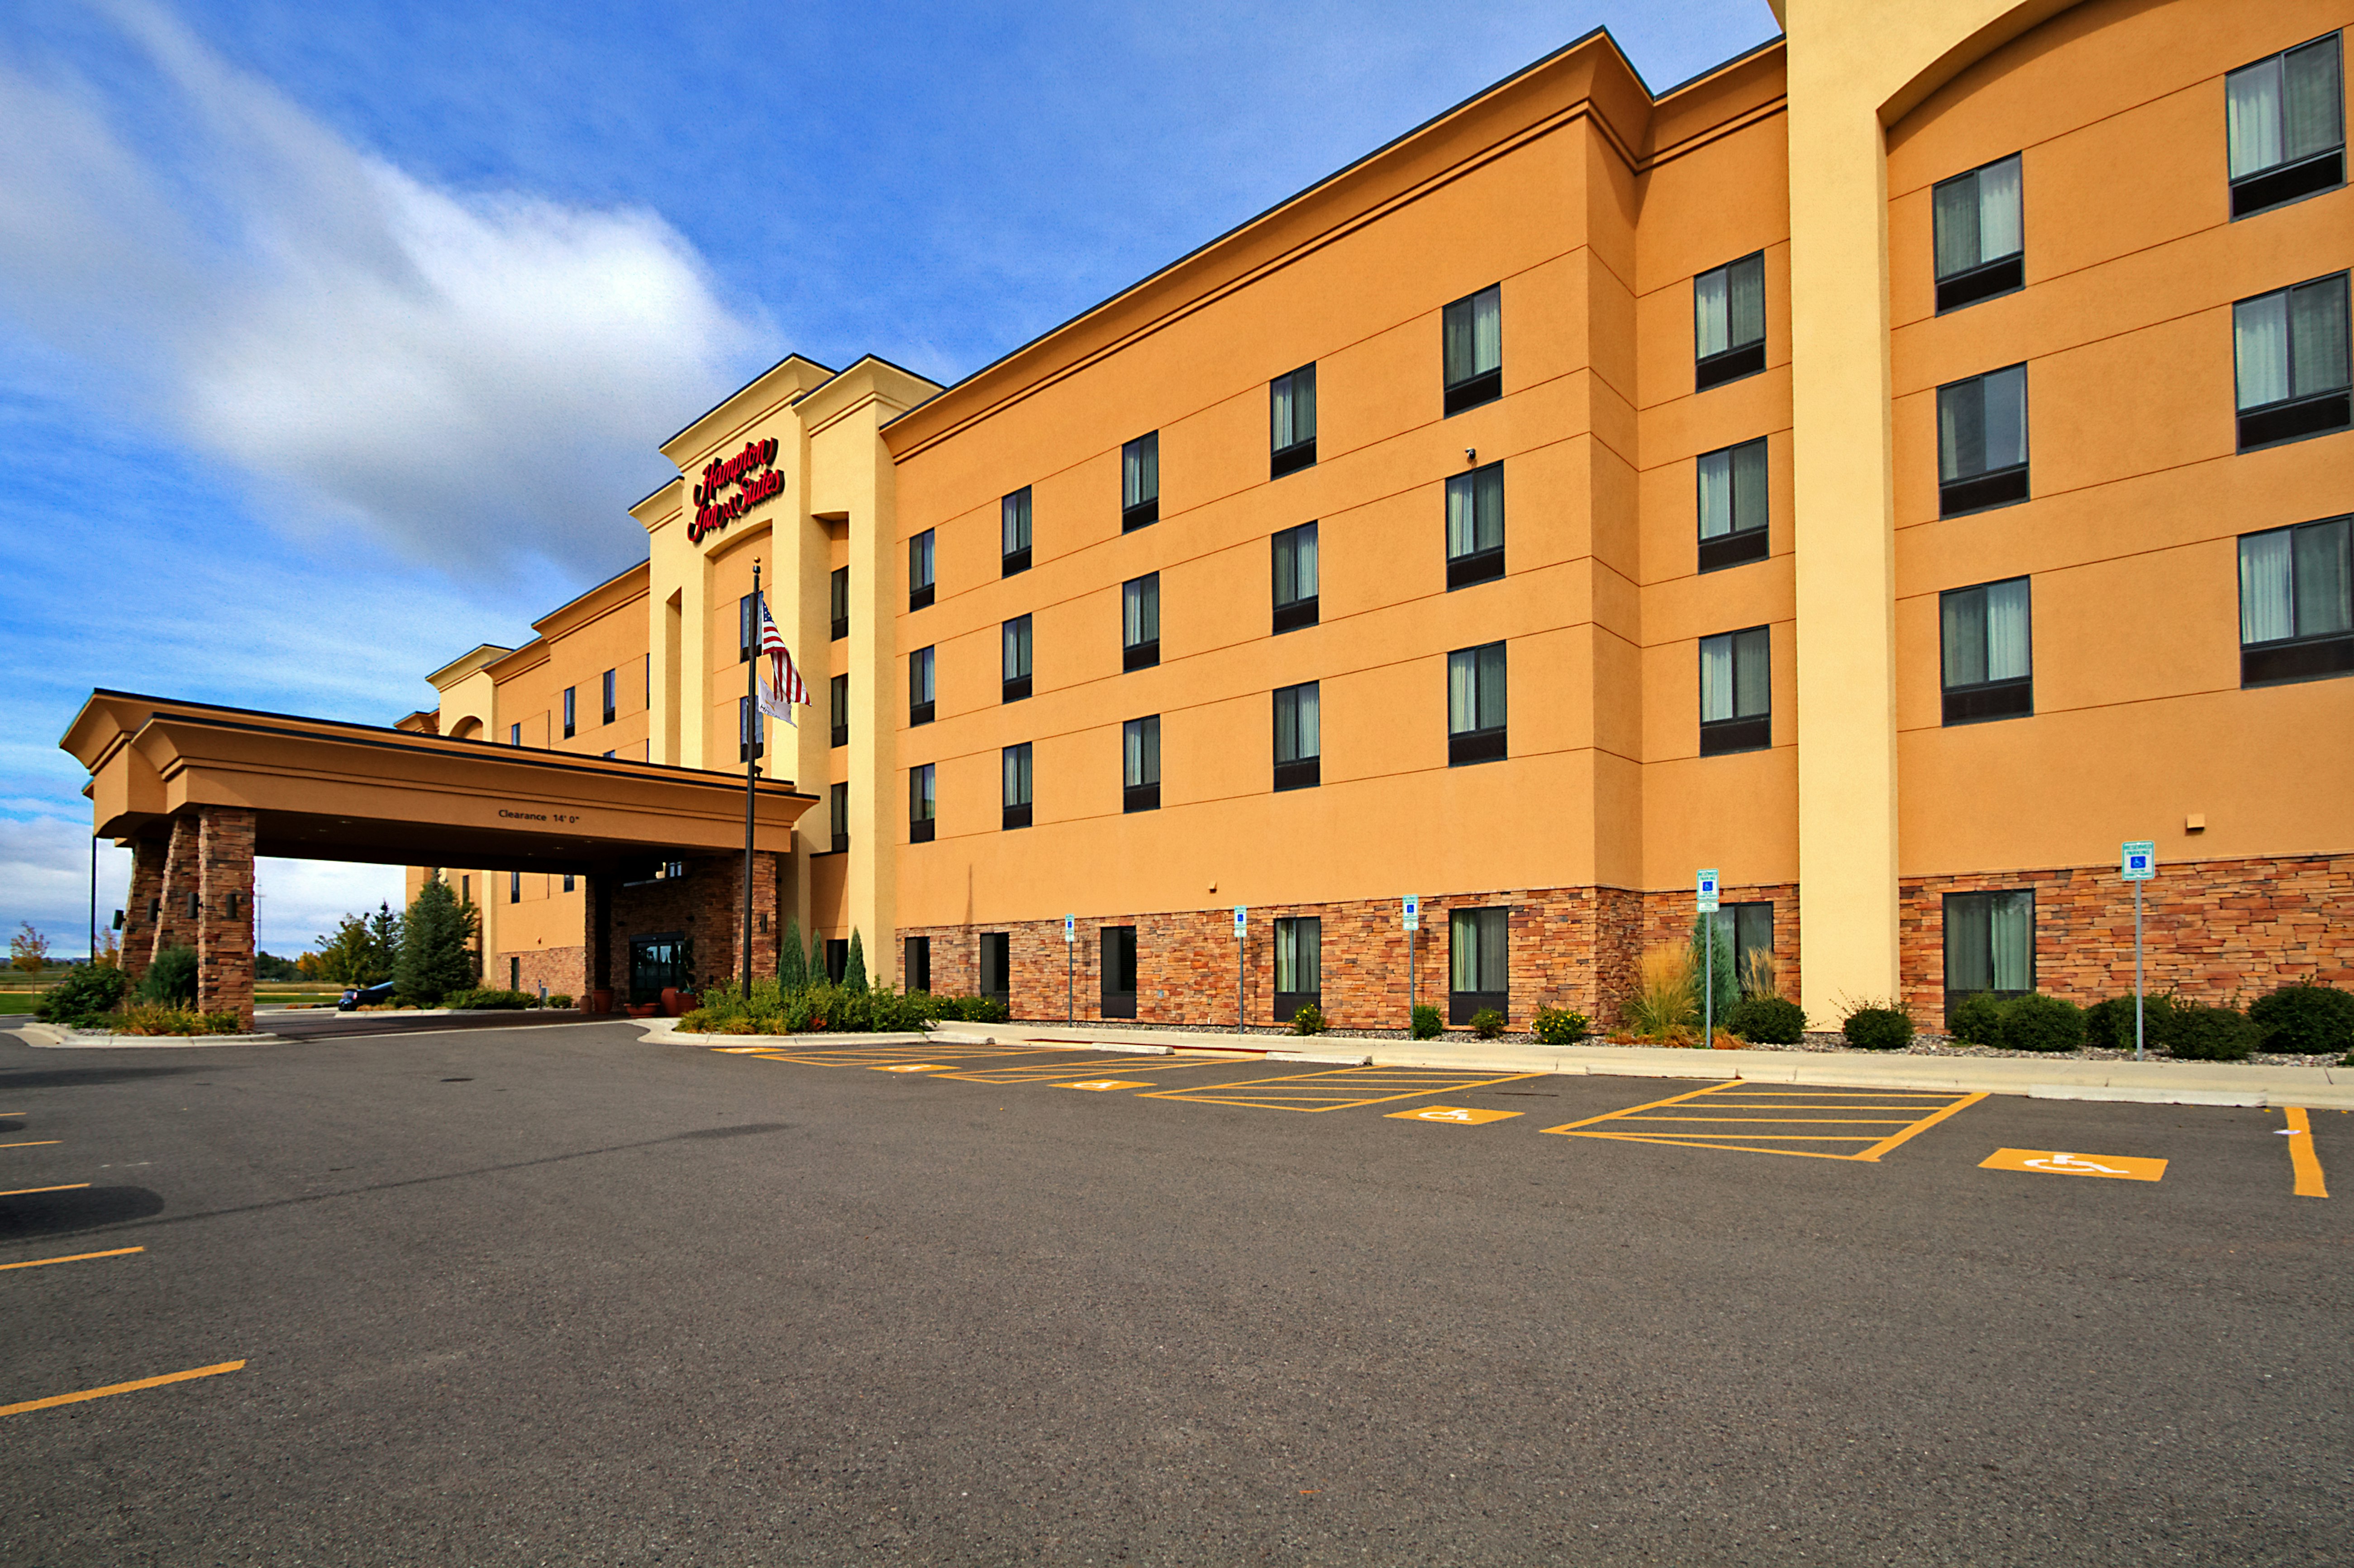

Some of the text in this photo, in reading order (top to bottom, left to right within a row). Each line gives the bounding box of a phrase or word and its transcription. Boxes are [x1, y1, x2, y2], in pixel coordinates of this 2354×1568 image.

[687, 503, 729, 543] Inn
[734, 469, 785, 513] Suites
[693, 437, 778, 507] Hampton
[499, 810, 547, 821] Clearance
